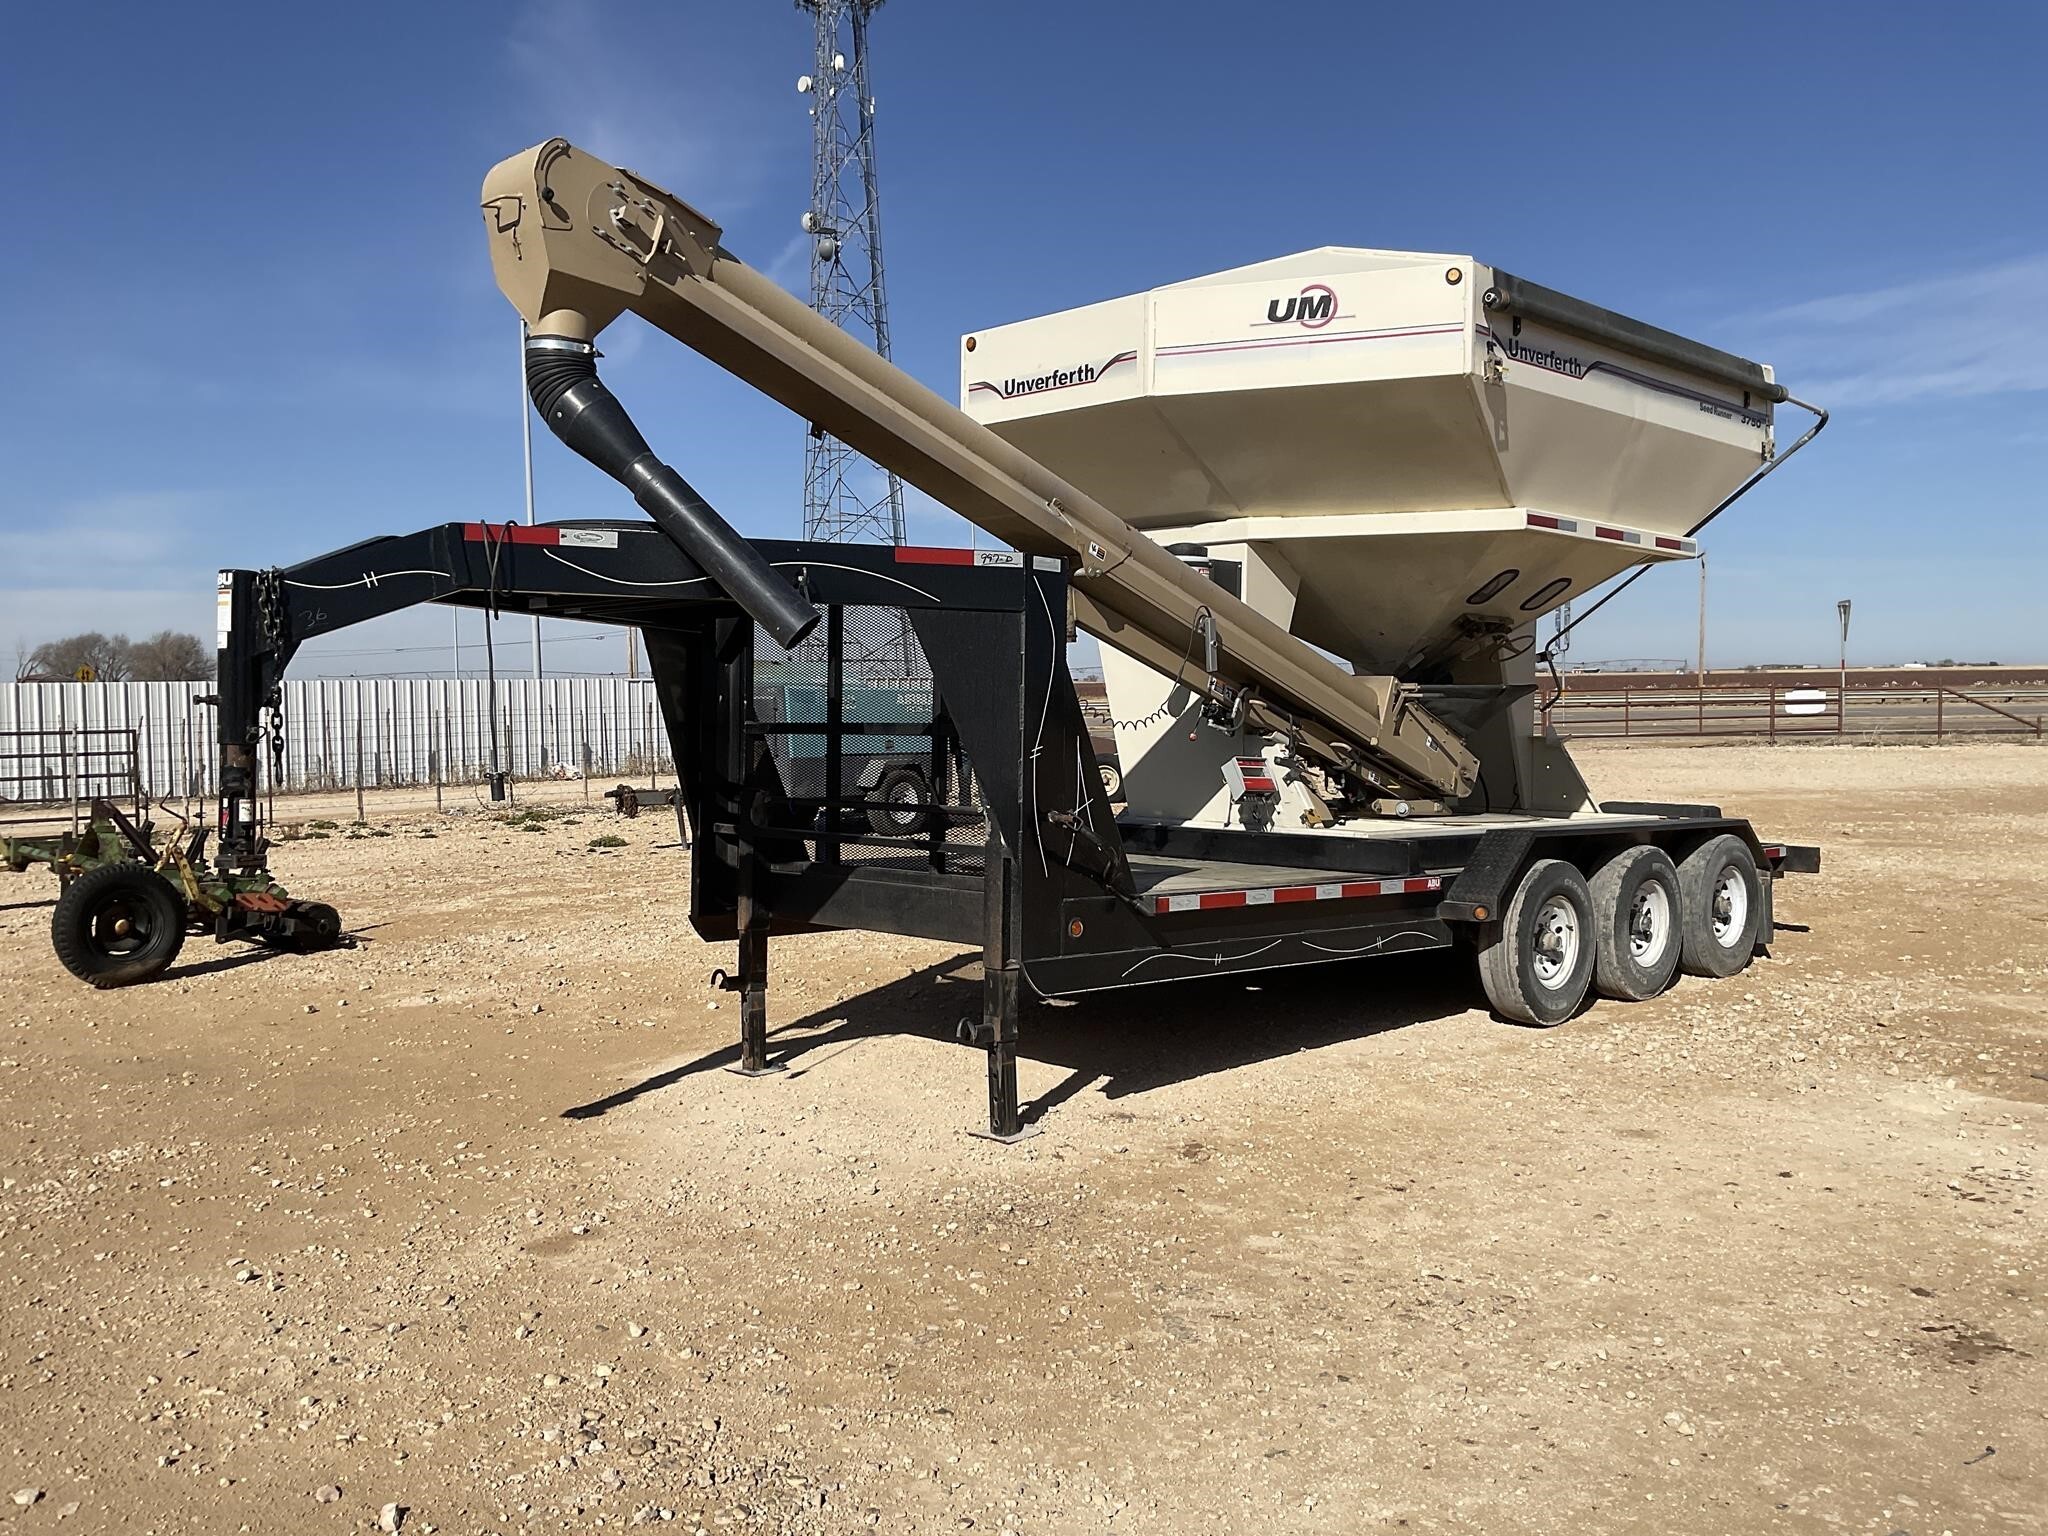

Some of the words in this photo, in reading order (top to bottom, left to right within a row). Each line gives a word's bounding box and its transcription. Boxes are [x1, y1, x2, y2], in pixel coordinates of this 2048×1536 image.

[1267, 294, 1332, 322] UM
[1507, 338, 1581, 376] Unverferth
[1004, 364, 1095, 395] Unverferth
[1741, 414, 1762, 428] 3750
